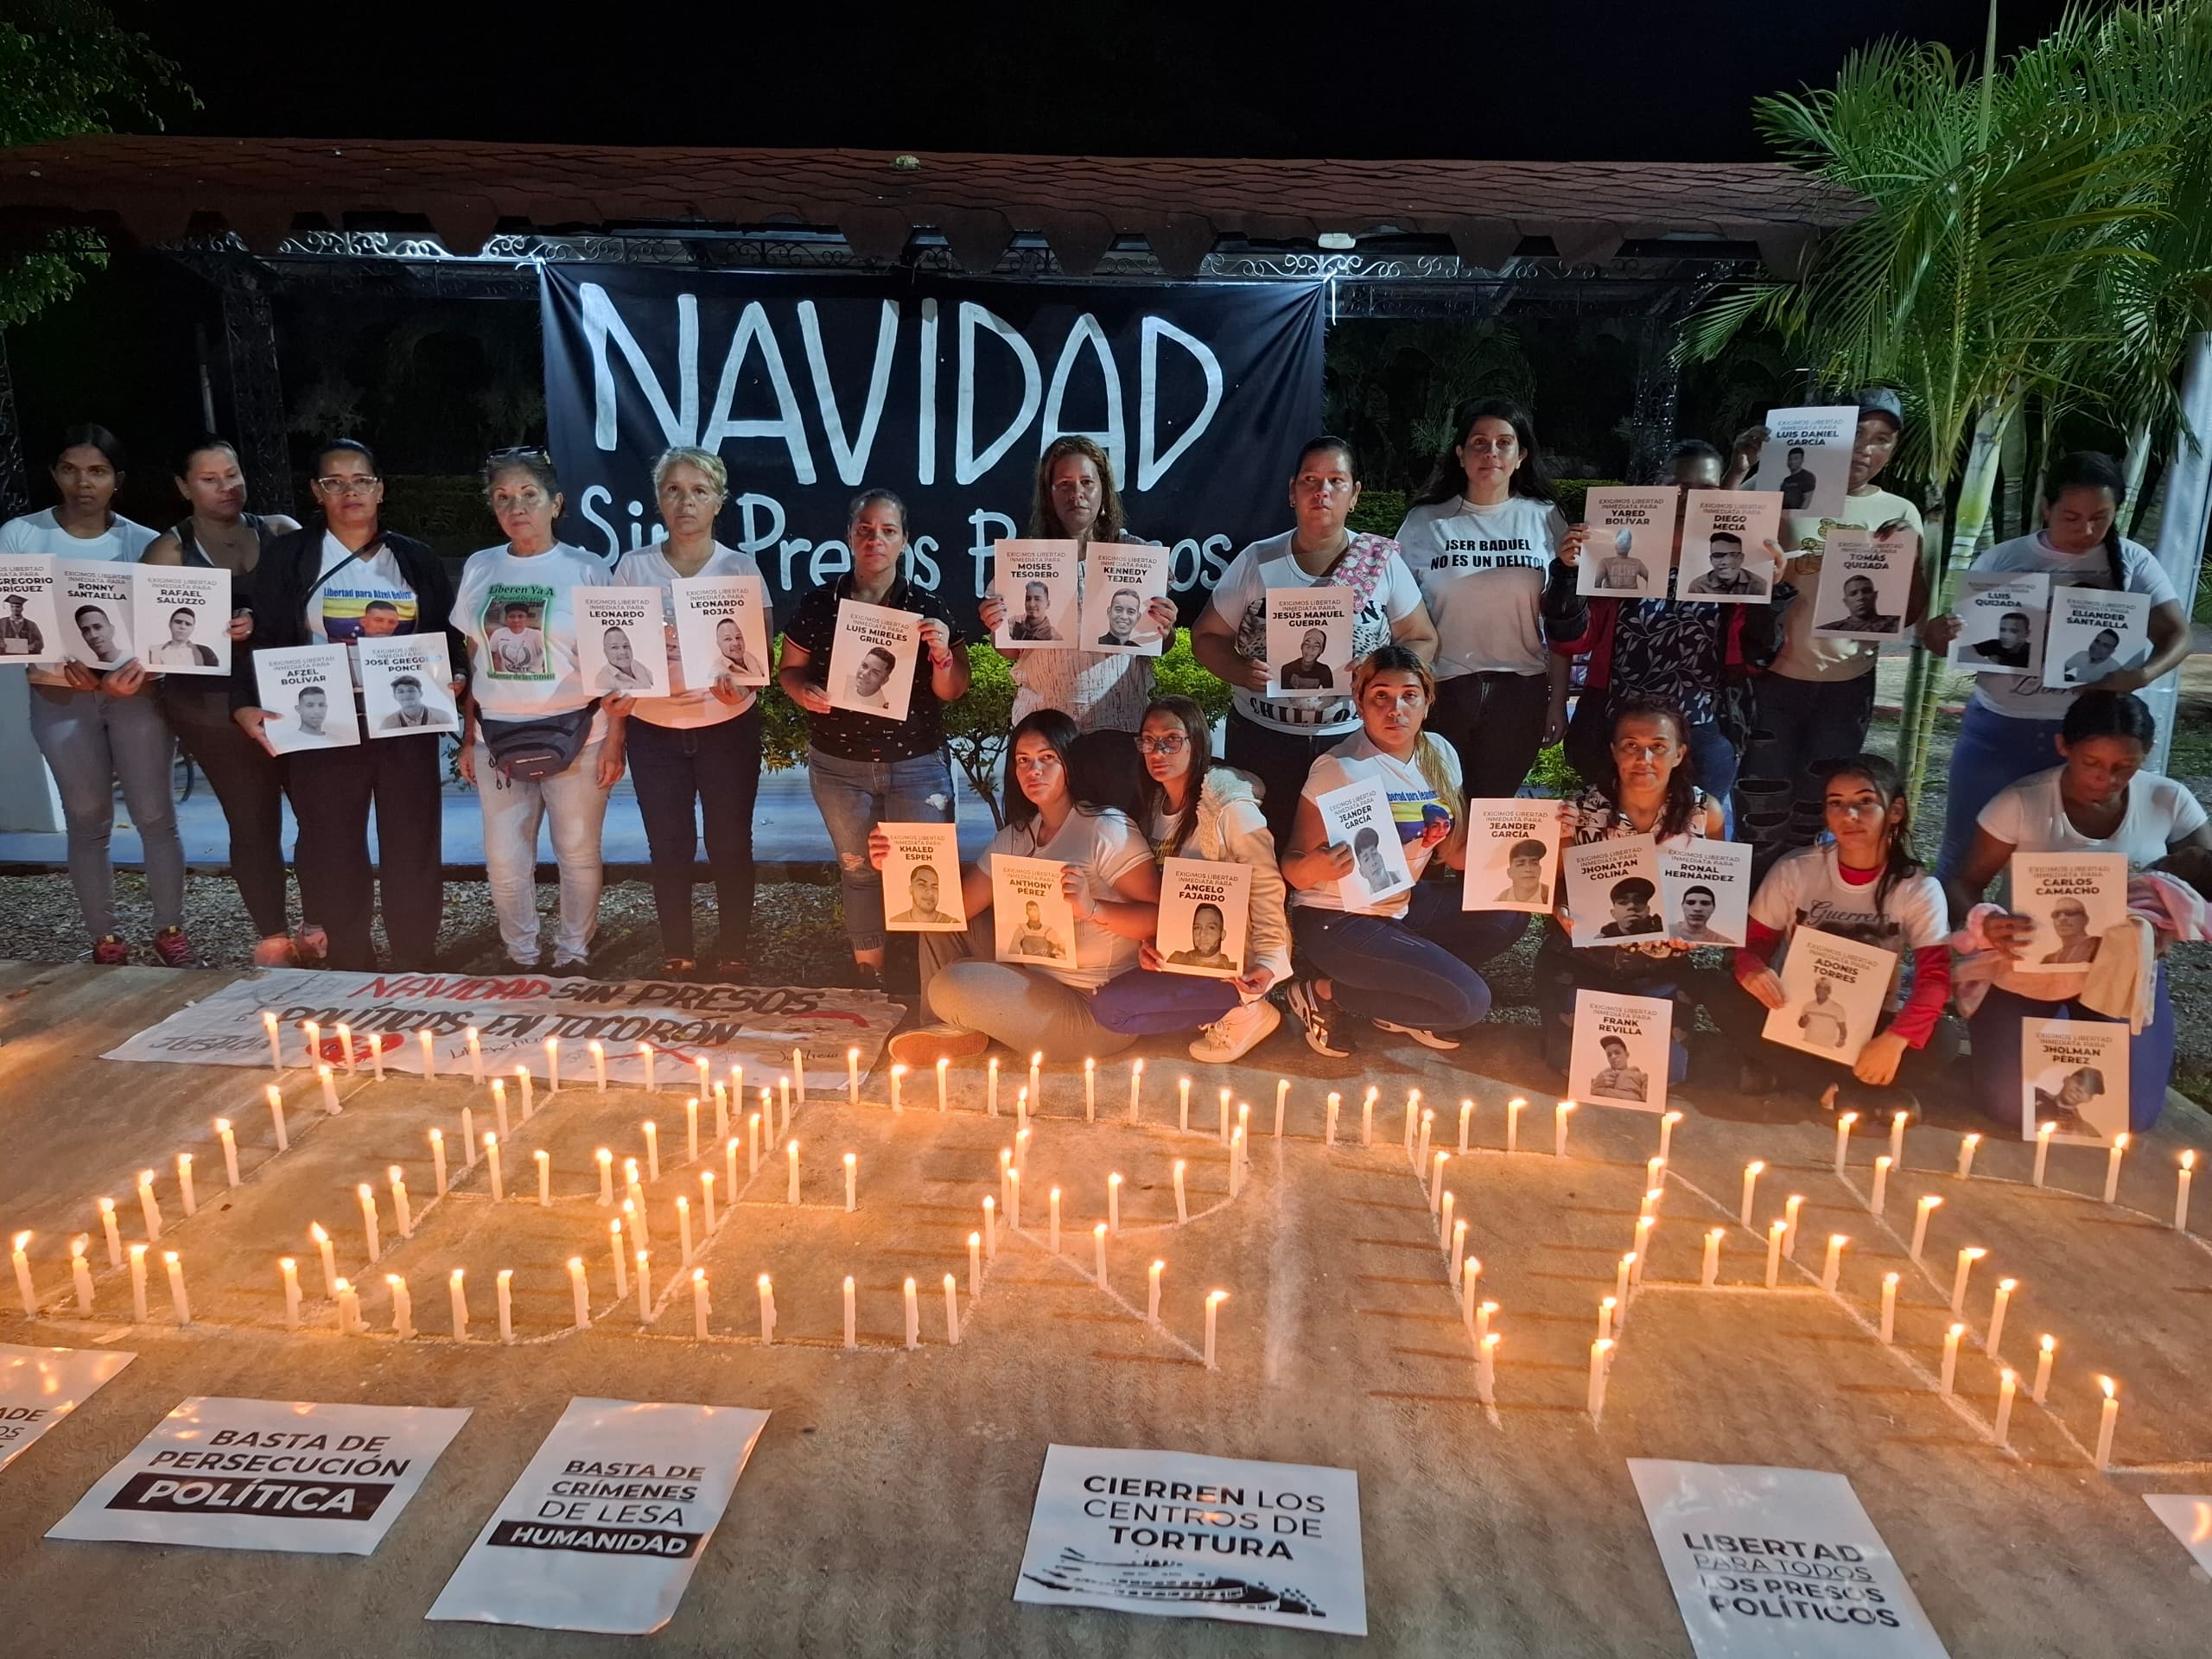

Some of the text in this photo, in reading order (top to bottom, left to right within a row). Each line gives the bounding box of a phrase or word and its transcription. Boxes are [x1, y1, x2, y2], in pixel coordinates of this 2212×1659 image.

[579, 282, 1224, 493] NAVIDAD
[1605, 517, 1649, 525] BOLÍVAR
[736, 493, 941, 591] Pres
[1479, 538, 1532, 551] BADUEL
[1430, 555, 1448, 570] NO
[1452, 554, 1468, 567] ES
[1472, 556, 1491, 567] UN
[1104, 566, 1147, 576] KENNEDY
[1108, 575, 1141, 583] TEJEDA
[68, 590, 127, 601] SANTAELLA
[324, 588, 353, 597] Libertad
[691, 600, 745, 608] LEONARDO
[851, 613, 909, 629] EXIGIMOS LIBERTAD
[853, 620, 886, 629] INMEDIATA
[2067, 617, 2128, 629] SANTAELLA
[847, 624, 907, 641] LUIS MIRELES
[860, 635, 892, 646] GRILLO
[392, 655, 442, 664] GREGO
[287, 669, 318, 677] AFZEL
[1249, 696, 1358, 725] CHILLO
[1330, 798, 1352, 811] EXIGIMOS
[1352, 791, 1376, 804] LIBERTAD
[1334, 798, 1374, 815] INMEDIATA PARA
[1339, 805, 1372, 823] JEANDER
[1345, 815, 1372, 830] GARCÍA
[1576, 848, 1642, 863] EXIGIMOS LIBERTAD
[1580, 858, 1616, 867] INMEDIATA
[1581, 859, 1637, 874] JHONATAN
[1590, 868, 1629, 880] COLINA
[1681, 864, 1719, 873] RONAL
[1009, 880, 1052, 890] ANTHONY
[1184, 884, 1224, 893] ANGELO
[1179, 892, 1225, 902] FAJARDO
[1813, 965, 1856, 983] TORRES
[1815, 957, 1859, 976] ADONIS
[347, 976, 825, 1014] NAVIDAD SIN PRESOS
[1590, 1003, 1623, 1012] EXIGIMOS
[1592, 1008, 1630, 1018] INMEDIATA
[1604, 1016, 1638, 1027] FRANK
[479, 1014, 547, 1037] EN
[551, 1014, 742, 1046] TOCORÓN
[1599, 1025, 1643, 1035] REVILLA
[2043, 1046, 2101, 1056] JHOLMAN
[209, 1430, 391, 1452] BASTA DE
[148, 1451, 410, 1477] PERSECUCIÓN
[564, 1460, 705, 1480] BASTA DE
[137, 1478, 357, 1513] POLÍTICA
[551, 1479, 698, 1501] CRÍMENES
[1084, 1475, 1325, 1513] CIERREN LOS
[537, 1500, 684, 1527] DE LESA
[1084, 1499, 1322, 1538] CENTROS DE
[510, 1526, 688, 1554] HUMANIDAD
[1109, 1525, 1294, 1560] TORTURA
[1682, 1533, 1864, 1562] LIBERTAD
[1694, 1554, 1873, 1581] PARA TODOS
[1764, 1580, 1885, 1603] PRESOS
[1709, 1594, 1900, 1628] POLÍTICOS
